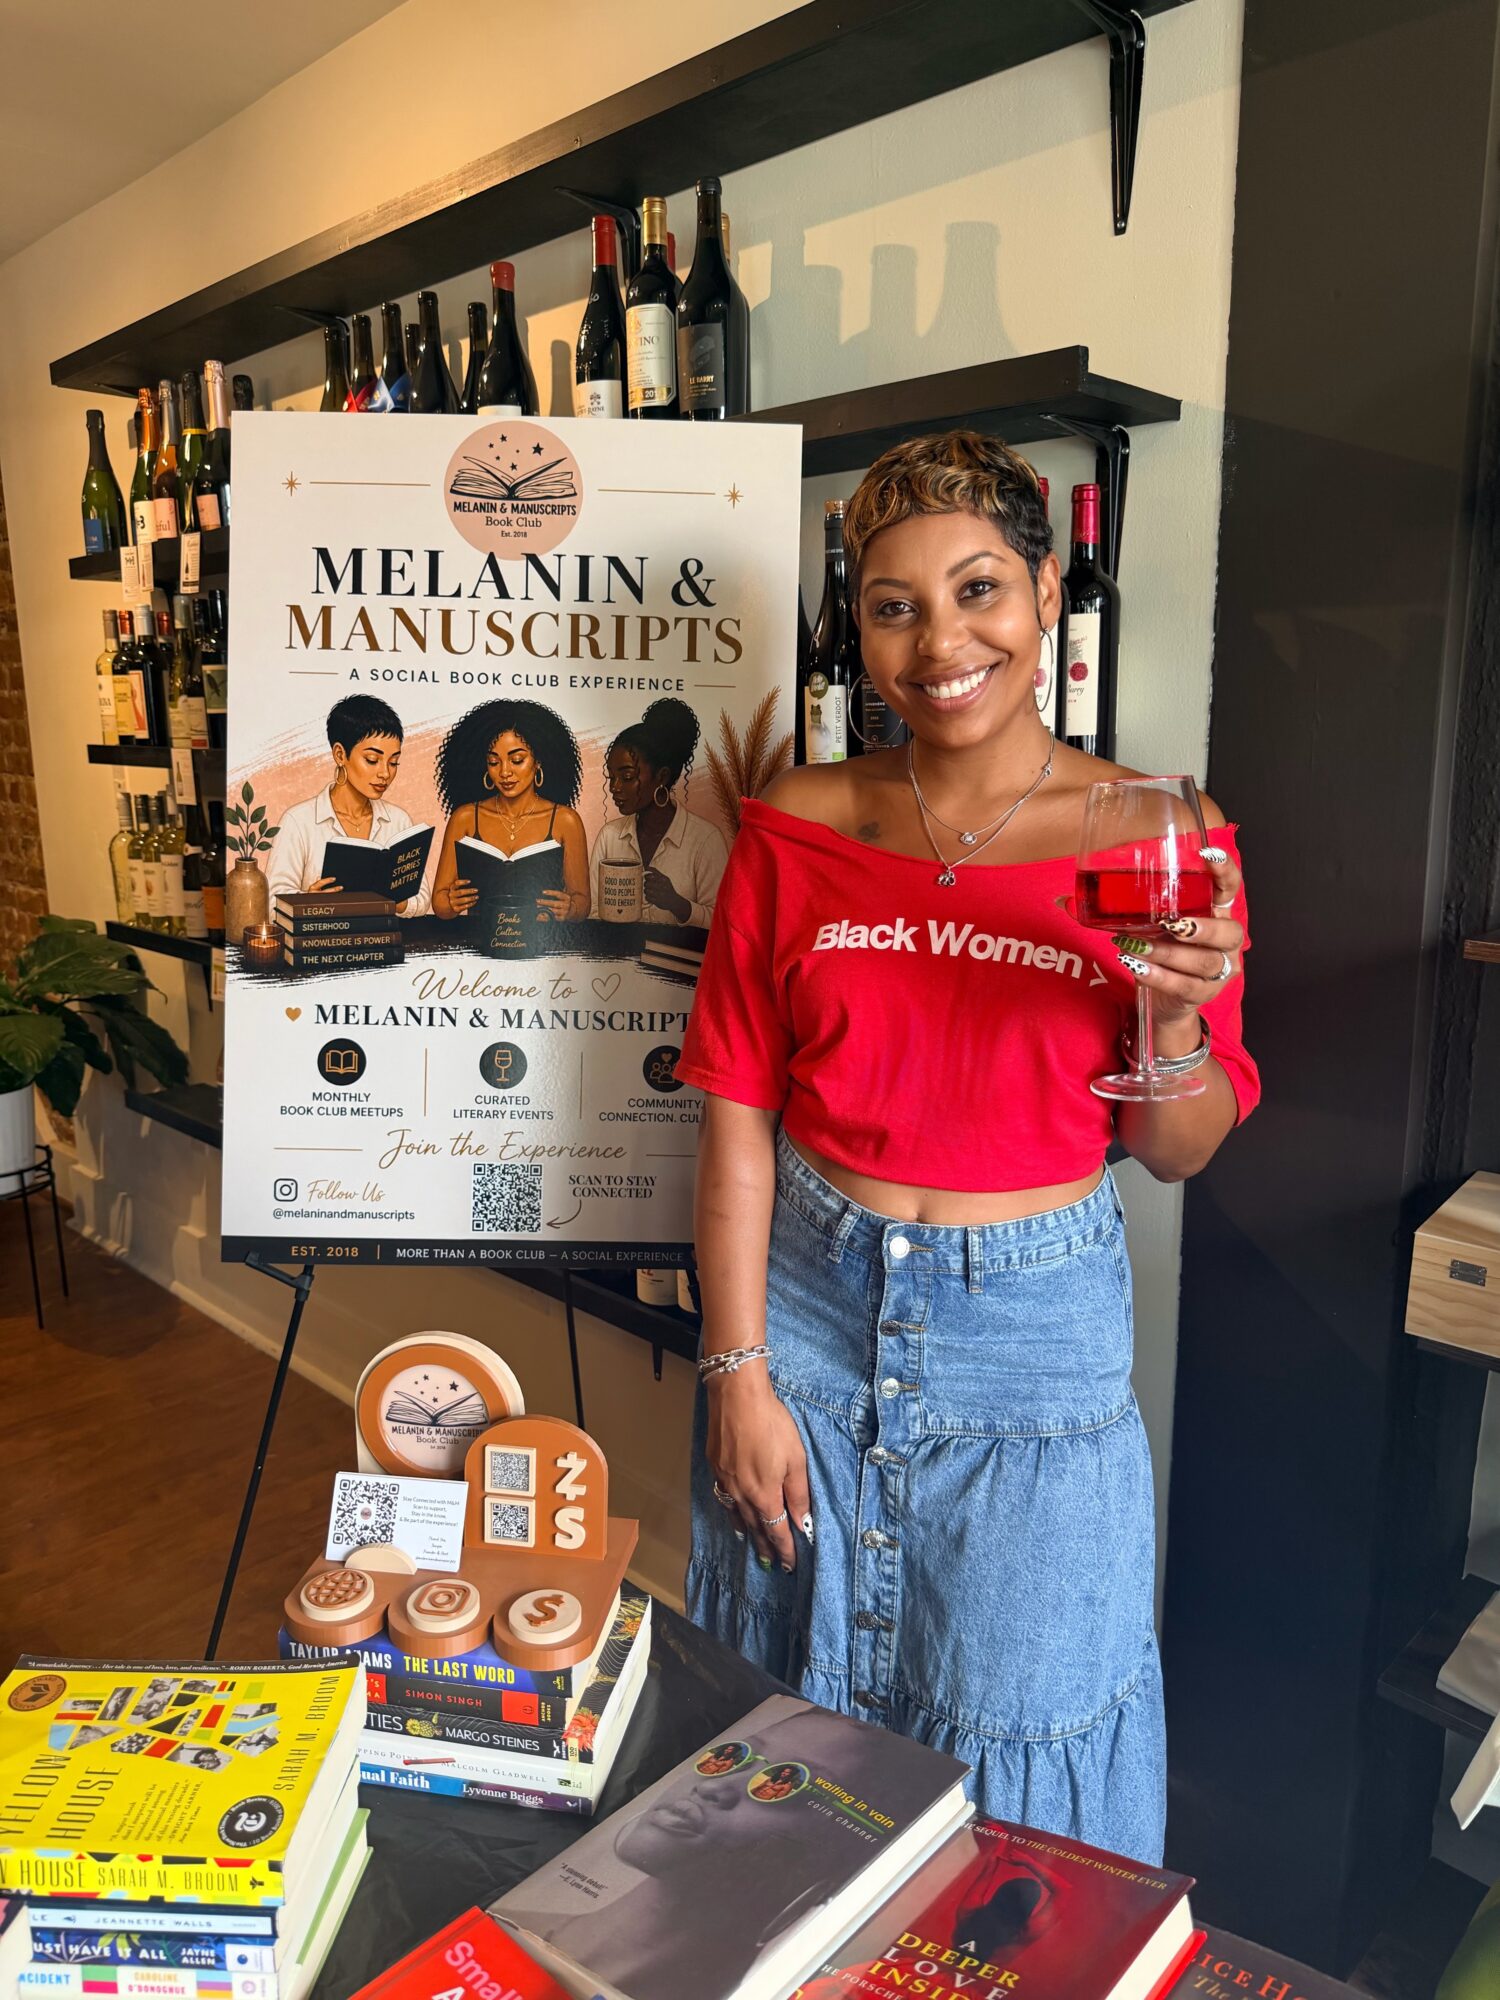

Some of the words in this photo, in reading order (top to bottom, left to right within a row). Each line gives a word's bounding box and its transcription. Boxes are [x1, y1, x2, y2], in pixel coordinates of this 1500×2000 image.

[453, 501, 496, 514] MELANIN
[500, 502, 508, 514] &
[510, 502, 577, 516] MANUSCRIPTS
[485, 516, 512, 528] Book
[514, 516, 542, 528] Club
[501, 530, 513, 538] Est.
[514, 530, 528, 538] 2018
[312, 546, 649, 606] MELANIN
[671, 557, 717, 608] &
[285, 604, 744, 665] MANUSCRIPTS
[349, 668, 361, 681] A
[370, 668, 440, 684] SOCIAL
[450, 671, 502, 686] BOOK
[511, 672, 559, 688] CLUB
[570, 674, 685, 692] EXPERIENCE
[834, 696, 842, 723] VERDOT
[397, 846, 422, 865] BLACK
[392, 858, 422, 878] STORIES
[390, 870, 419, 891] MATTER
[605, 876, 618, 886] GOOD
[619, 878, 636, 886] BOOKS
[604, 888, 617, 896] GOOD
[618, 888, 635, 896] PEOPLE
[604, 898, 616, 906] GOOD
[618, 898, 636, 906] ENERGY
[302, 906, 336, 917] LEGACY
[496, 912, 522, 926] Books
[302, 921, 350, 932] SISTERHOOD
[494, 926, 522, 938] Culture
[302, 937, 352, 948] KNOWLEDGE
[354, 936, 364, 946] IS
[366, 935, 392, 946] POWER
[490, 938, 527, 950] Connection
[812, 918, 920, 952] Black
[926, 919, 1084, 980] Women
[302, 954, 318, 964] THE
[320, 953, 344, 964] NEXT
[346, 951, 384, 963] CHAPTER
[411, 968, 543, 1001] Welcome
[548, 975, 578, 1000] to
[315, 1004, 459, 1028] MELANIN
[469, 1006, 490, 1029] &
[312, 1092, 371, 1103] MONTHLY
[474, 1095, 530, 1106] CURATED
[280, 1105, 314, 1117] BOOK
[316, 1106, 348, 1117] CLUB
[350, 1106, 404, 1118] MEETUPS
[453, 1109, 507, 1120] LITERARY
[510, 1110, 554, 1121] EVENTS
[598, 1112, 676, 1123] CONNECTION.
[378, 1128, 442, 1169] Join
[449, 1131, 489, 1158] the
[499, 1131, 628, 1163] Experience
[568, 1174, 602, 1186] SCAN
[604, 1175, 624, 1186] TO
[626, 1175, 657, 1188] STAY
[306, 1179, 358, 1204] Follow
[361, 1180, 385, 1204] Us
[572, 1186, 654, 1199] CONNECTED
[272, 1208, 415, 1223] @melaninandmanuscripts
[291, 1246, 321, 1257] EST.
[326, 1246, 360, 1258] 2018
[396, 1248, 430, 1259] MORE
[433, 1248, 465, 1259] THAN
[468, 1249, 477, 1259] A
[480, 1250, 512, 1260] BOOK
[516, 1250, 546, 1260] CLUB
[560, 1250, 568, 1260] A
[572, 1251, 612, 1261] SOCIAL
[616, 1252, 684, 1262] EXPERIENCE
[392, 1425, 424, 1435] MELANIN
[426, 1428, 432, 1436] &
[416, 1436, 437, 1444] Book
[440, 1436, 460, 1444] Club
[403, 1655, 430, 1675] THE
[434, 1659, 471, 1680] LAST
[474, 1664, 516, 1685] WORD
[305, 1676, 340, 1720] BROOM
[405, 1689, 442, 1704] SIMON
[446, 1692, 482, 1708] SINGH
[296, 1728, 320, 1741] M.
[446, 1726, 490, 1744] MARGO
[493, 1732, 540, 1751] STEINES
[274, 1734, 311, 1791] SARAH
[493, 1768, 548, 1783] GLADWELL
[360, 1770, 386, 1783] ual
[390, 1771, 430, 1789] Faith
[462, 1784, 508, 1800] Lyvonne
[510, 1791, 544, 1806] Briggs
[46, 1767, 122, 1840] HOUSE
[815, 1776, 856, 1804] waiting
[854, 1800, 868, 1812] in
[868, 1809, 896, 1828] vain
[807, 1800, 834, 1817] colin
[836, 1816, 878, 1843] channer
[974, 1825, 1010, 1841] SEQUEL
[1011, 1834, 1027, 1845] TO
[1026, 1840, 1047, 1852] THE
[1047, 1846, 1094, 1870] COLDEST
[1093, 1861, 1137, 1881] WINTER
[1137, 1876, 1168, 1890] EVER
[20, 1860, 87, 1888] HOUSE
[98, 1866, 148, 1888] SARAH
[156, 1870, 174, 1890] M.
[184, 1870, 239, 1892] BROOM
[94, 1917, 165, 1927] JEANNETTE
[173, 1920, 214, 1928] WALLS
[69, 1943, 111, 1957] HAVE
[116, 1946, 132, 1958] IT
[139, 1948, 167, 1960] ALL
[181, 1948, 216, 1958] JAYNE
[958, 1940, 978, 1953] A
[181, 1956, 216, 1966] ALLEN
[896, 1931, 1022, 1989] DEEPER
[134, 1972, 179, 1983] CAROLINE
[444, 1941, 523, 2000] Smal
[883, 1946, 1009, 2000] LOVE
[1192, 1954, 1254, 1988] ICE
[128, 1984, 186, 1996] O'DONOGHUE
[1194, 1975, 1231, 2000] The
